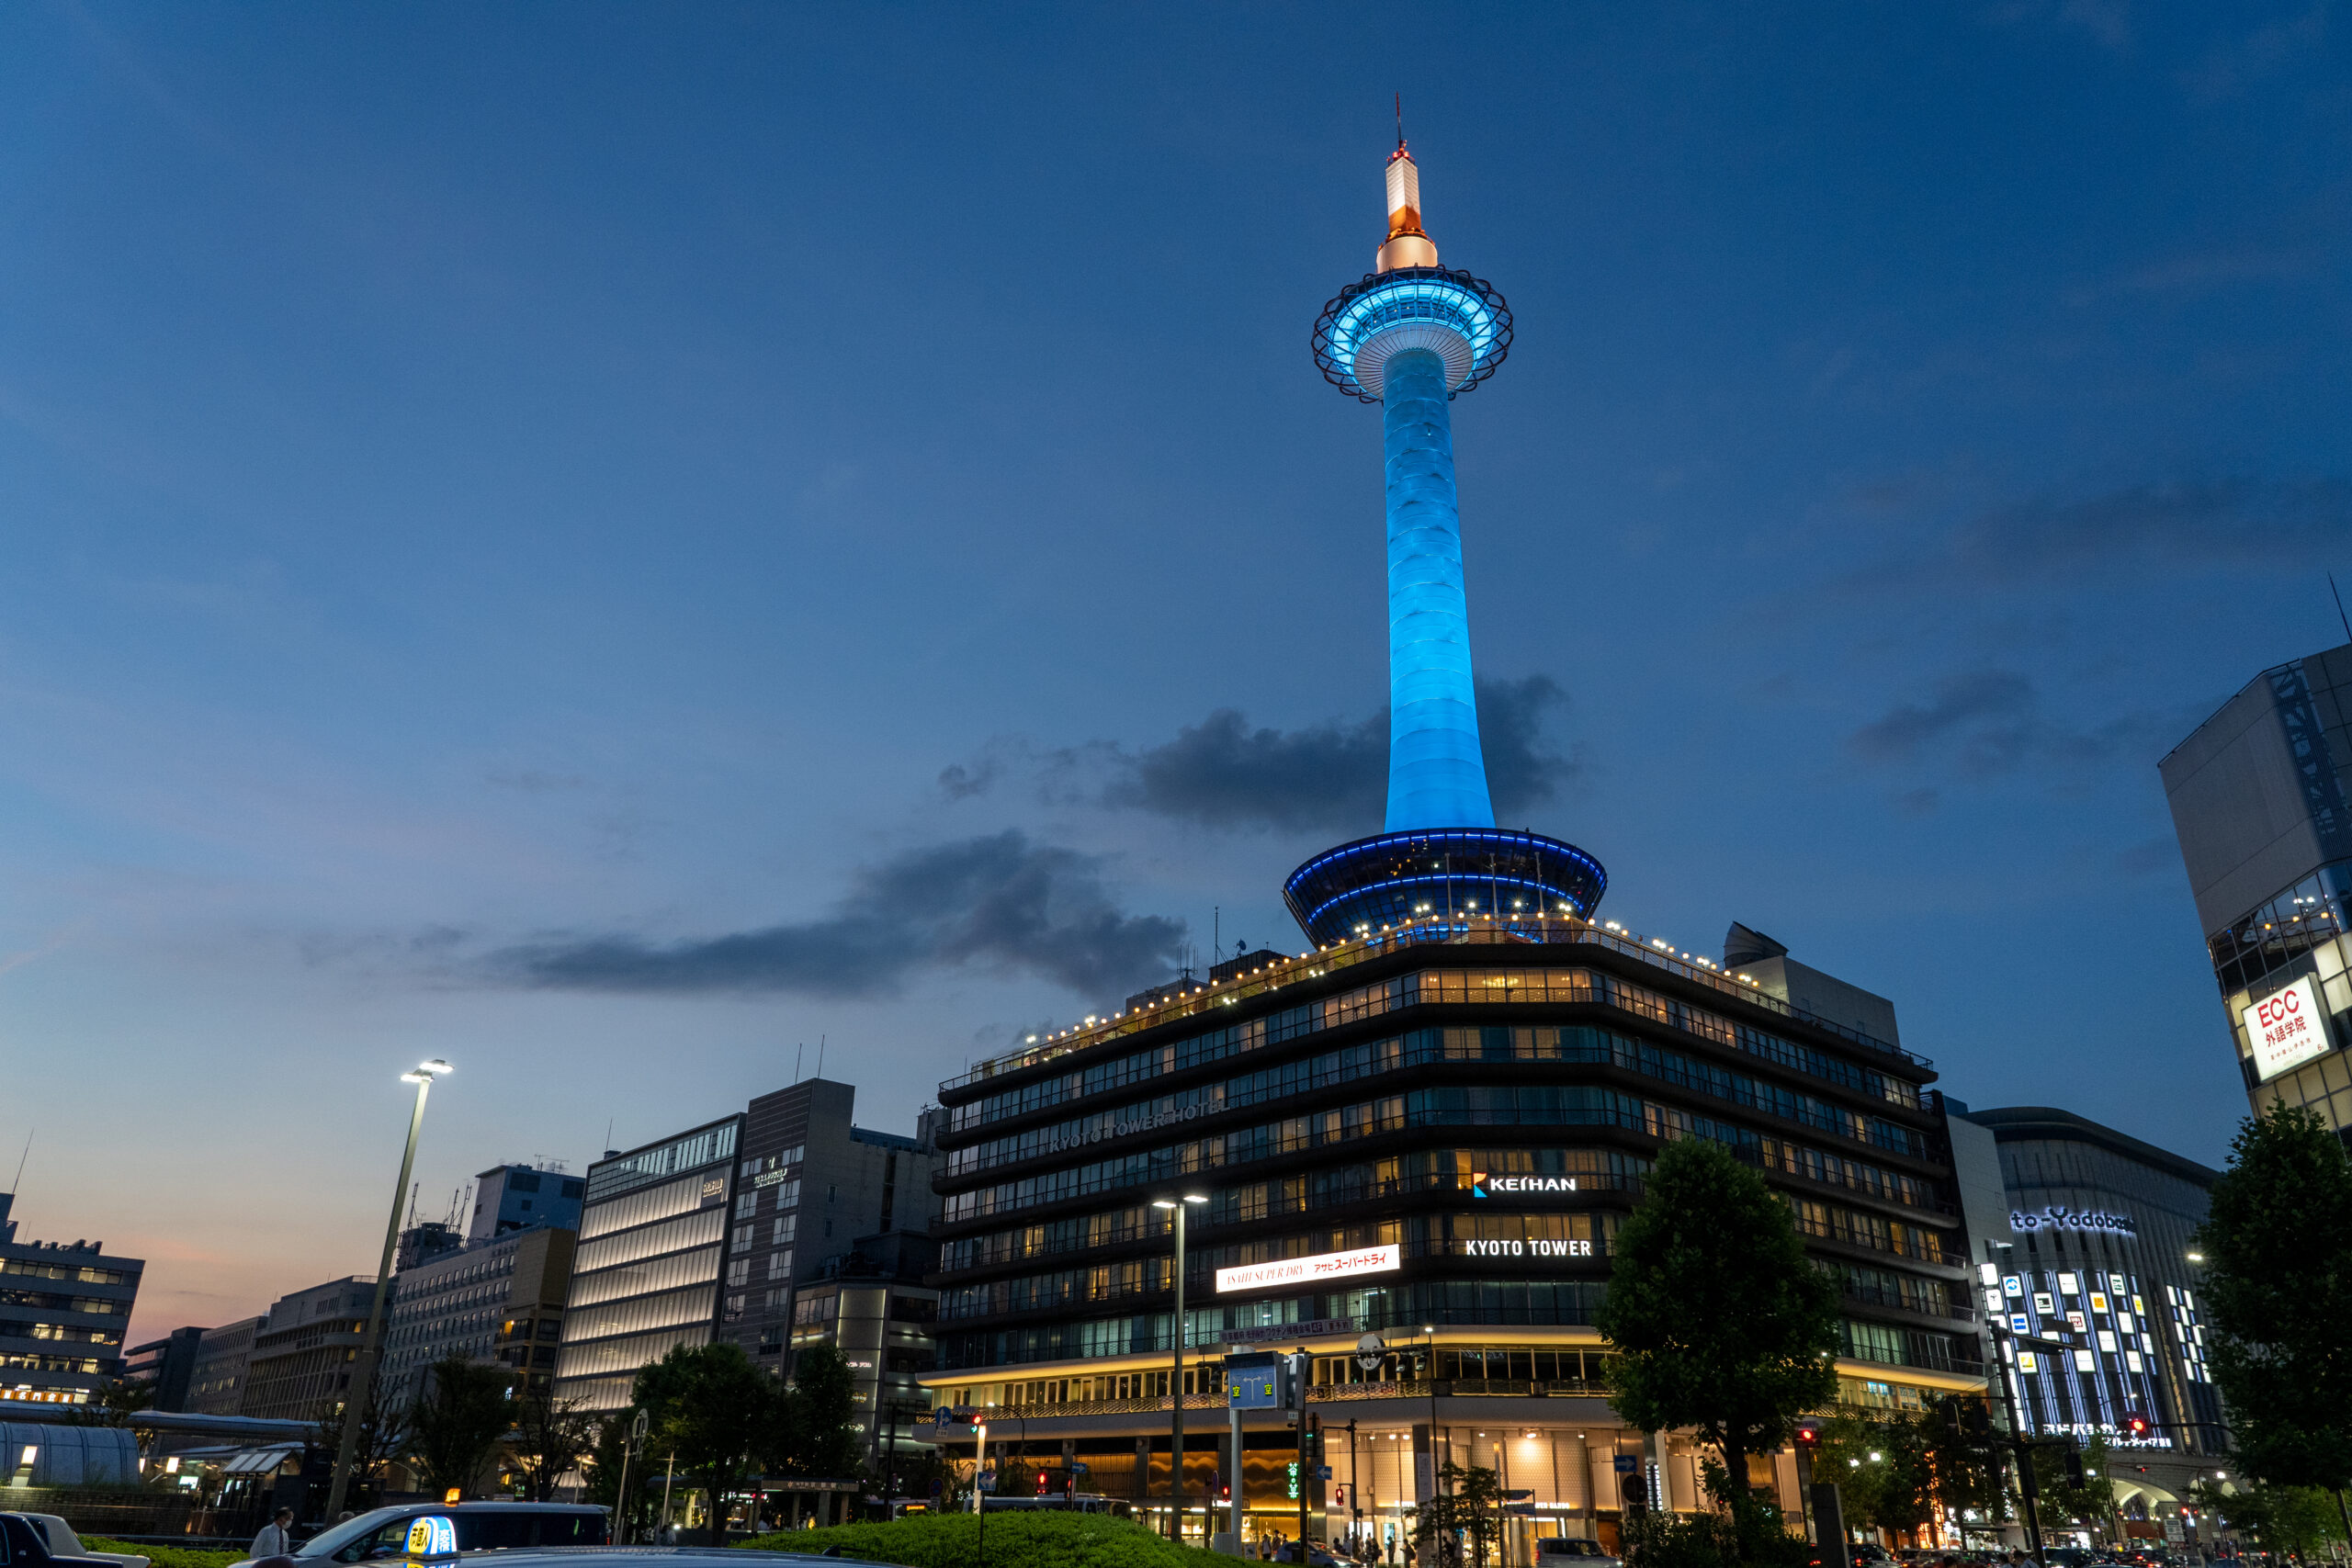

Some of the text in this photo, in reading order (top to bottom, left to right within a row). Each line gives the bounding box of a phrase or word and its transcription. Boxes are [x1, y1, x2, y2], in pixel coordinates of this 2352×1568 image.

[2257, 989, 2300, 1029] ECC
[2266, 1015, 2307, 1048] 外語学院
[1050, 1099, 1230, 1154] KYOTO TOWER HOTEL
[1490, 1176, 1577, 1191] KEIHAN
[1466, 1240, 1592, 1257] KYOTO TOWER
[1227, 1271, 1253, 1286] ASAHI
[1255, 1266, 1283, 1282] SUPER
[1285, 1264, 1303, 1278] DRY
[1232, 1385, 1240, 1397] 空
[1264, 1383, 1272, 1395] 空
